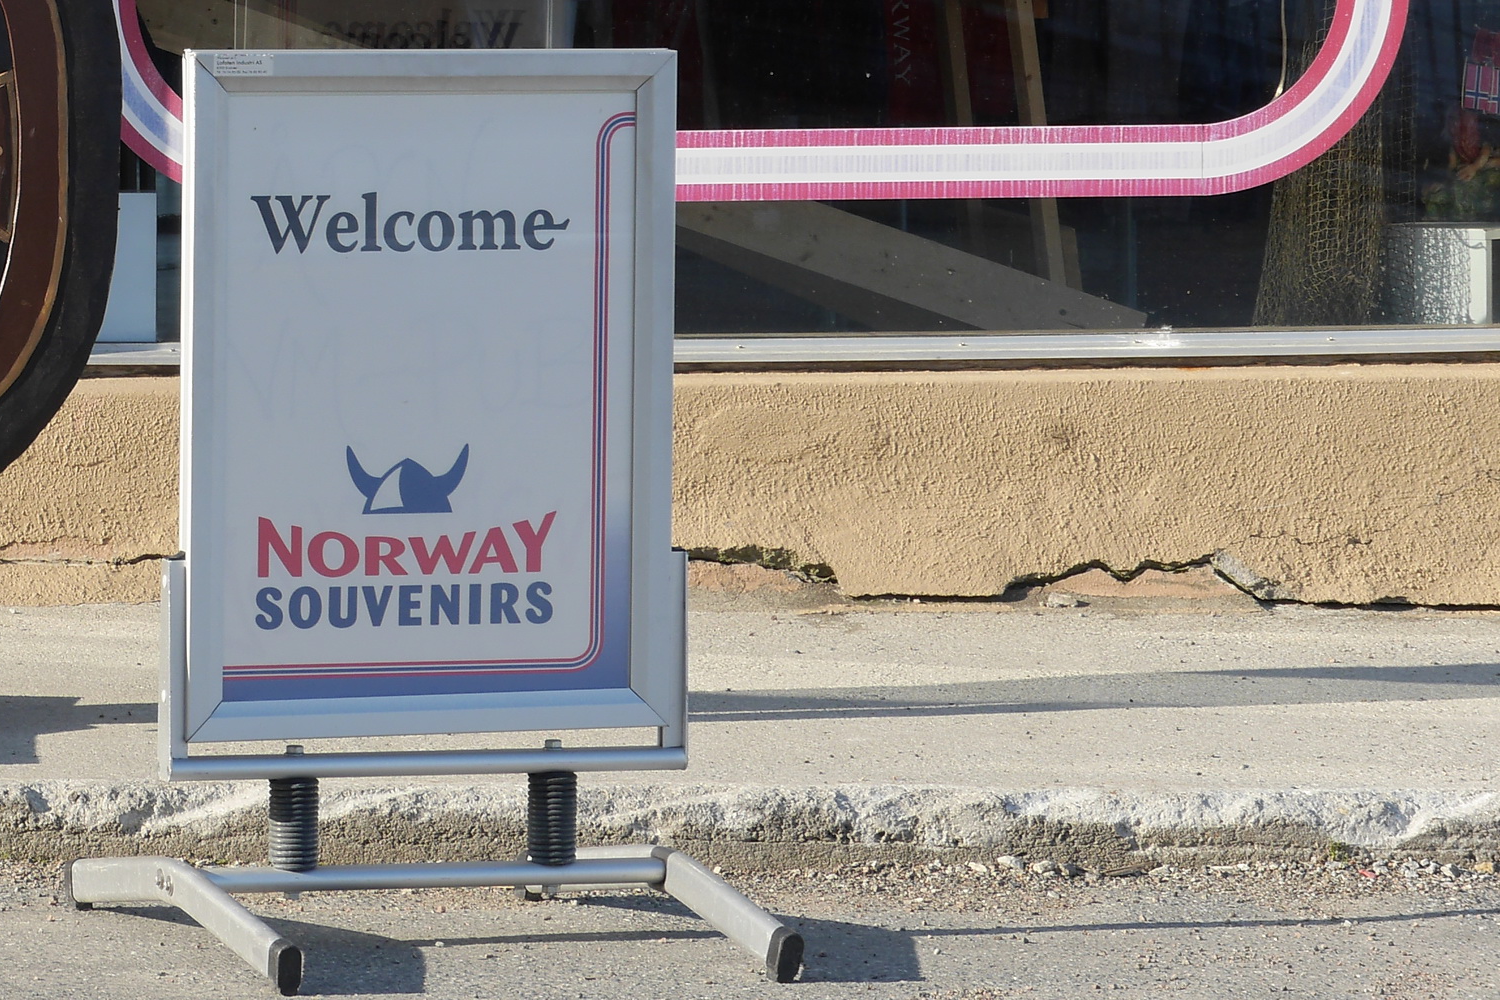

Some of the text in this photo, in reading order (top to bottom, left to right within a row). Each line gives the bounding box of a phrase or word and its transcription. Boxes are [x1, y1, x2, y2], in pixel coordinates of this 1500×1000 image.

[251, 191, 570, 254] Welcome
[257, 511, 558, 578] NORWAY
[255, 581, 554, 630] SOUVENIRS
